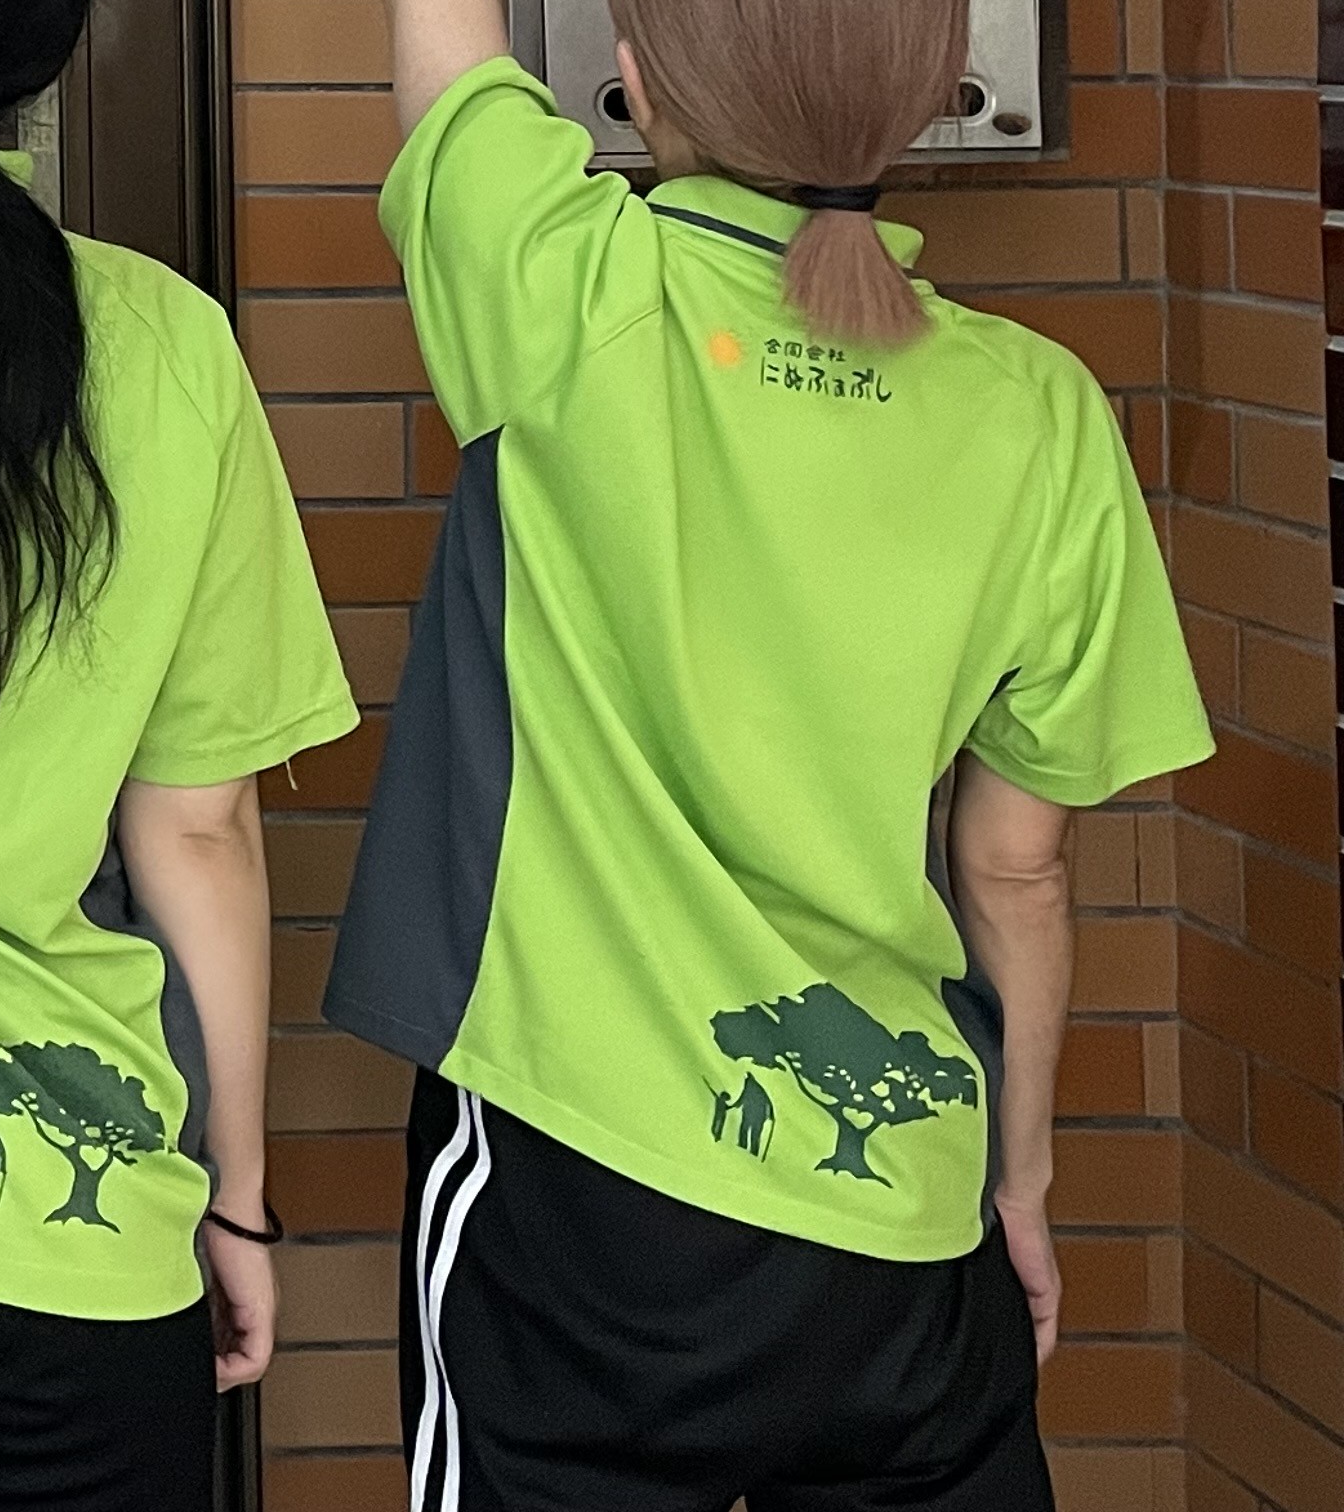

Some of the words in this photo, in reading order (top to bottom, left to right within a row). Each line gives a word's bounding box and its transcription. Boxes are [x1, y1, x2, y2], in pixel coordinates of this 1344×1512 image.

[760, 356, 893, 403] にぬふぁぶし
